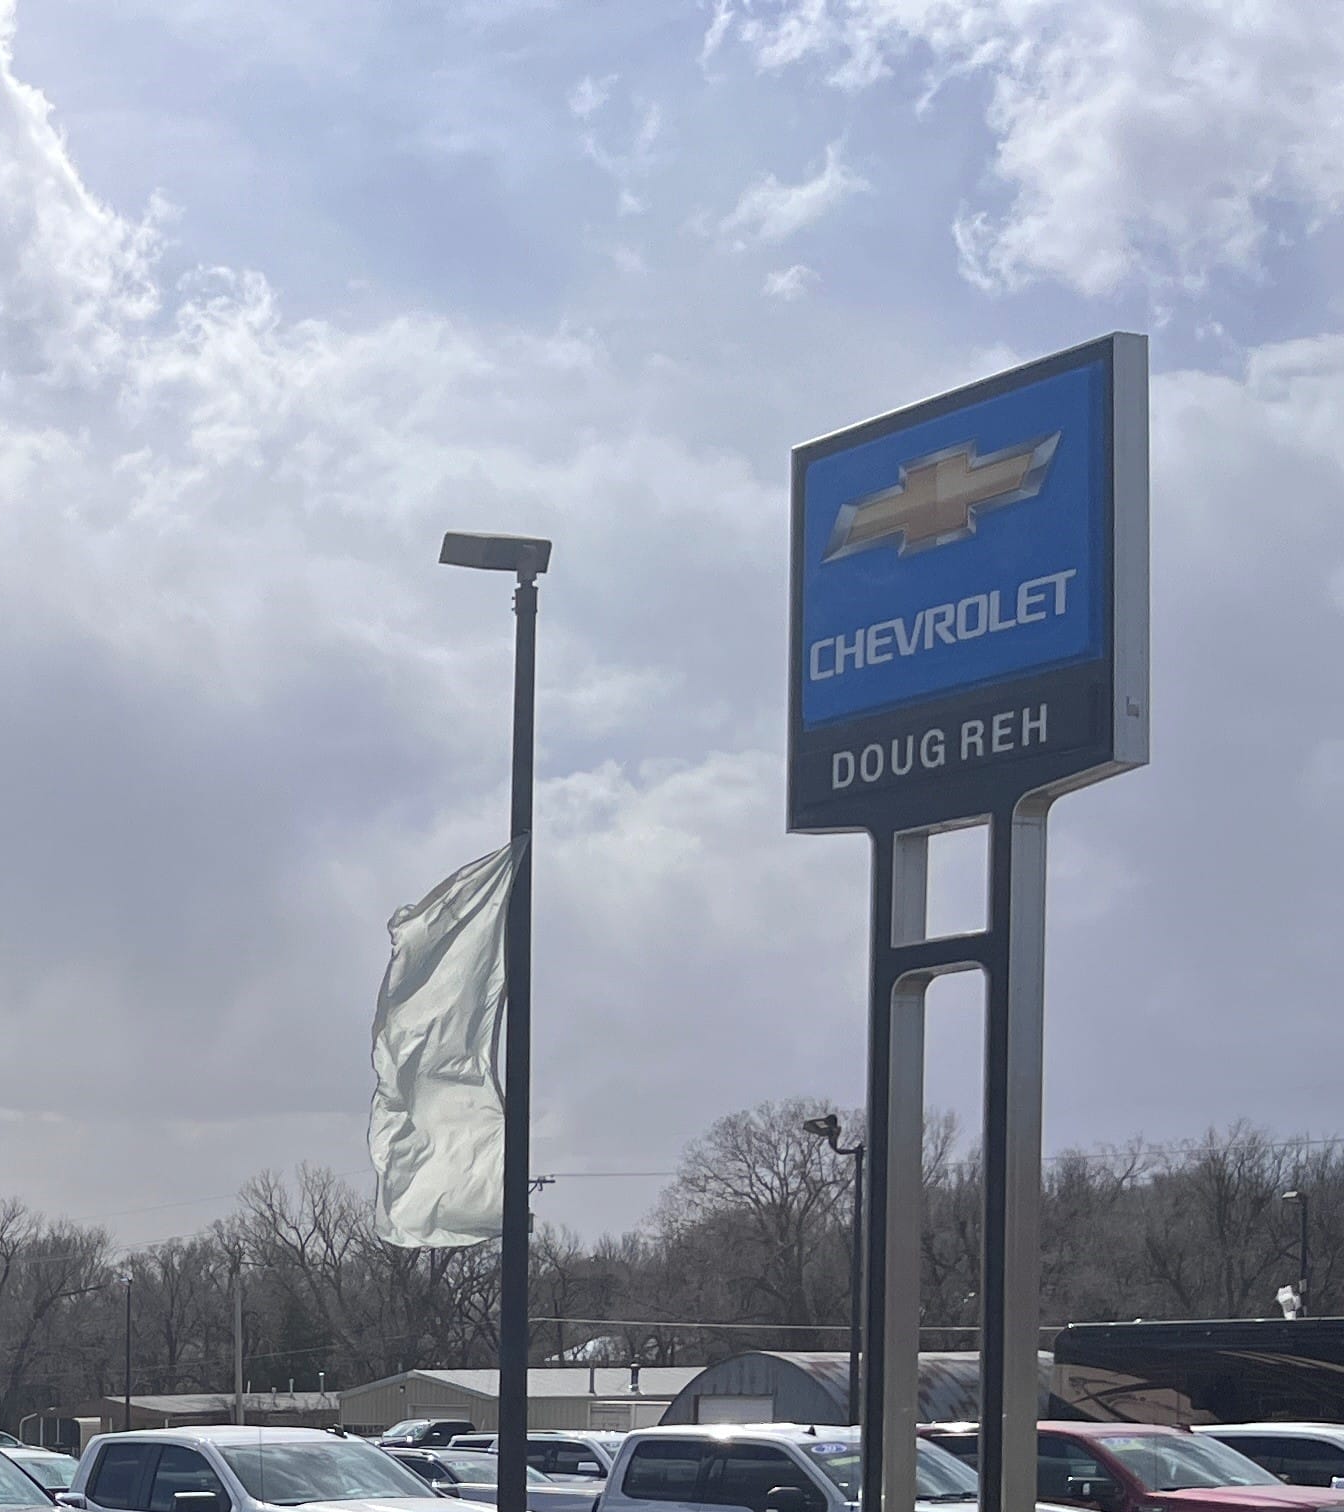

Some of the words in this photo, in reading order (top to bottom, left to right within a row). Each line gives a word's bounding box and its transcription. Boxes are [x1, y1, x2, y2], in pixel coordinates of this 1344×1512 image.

[810, 569, 1077, 681] CHEVROLET
[832, 728, 945, 790] DOUG
[961, 703, 1048, 761] REH
